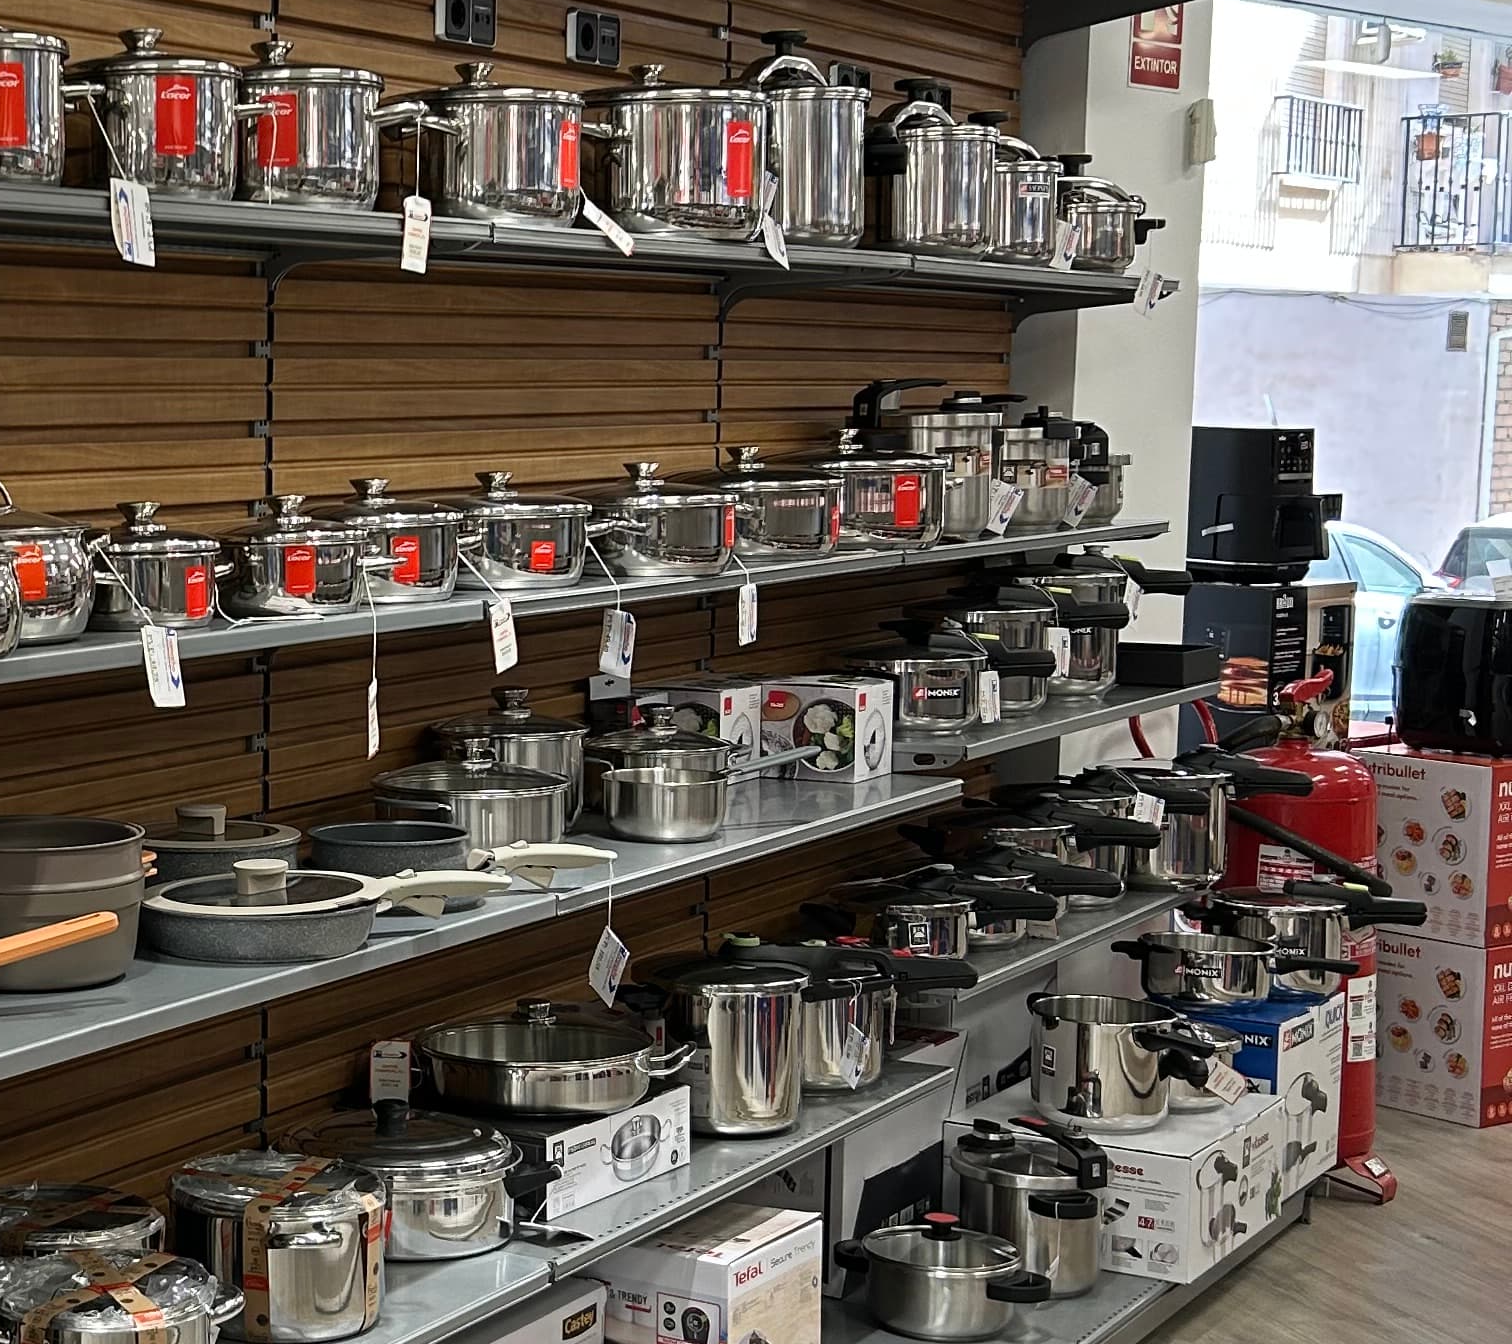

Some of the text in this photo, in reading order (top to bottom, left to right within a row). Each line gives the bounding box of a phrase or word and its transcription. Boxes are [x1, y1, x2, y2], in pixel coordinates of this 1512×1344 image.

[1134, 55, 1177, 75] EXTINTOR
[160, 89, 191, 101] Lacor
[394, 543, 417, 555] Lacor
[287, 552, 312, 563] Lacor
[927, 687, 962, 698] MONIX
[1364, 762, 1427, 781] utribullet
[1186, 968, 1219, 977] MONIX
[1291, 1020, 1313, 1044] MONIX
[1243, 1034, 1270, 1047] NIX
[1114, 1163, 1144, 1176] esse
[733, 1261, 763, 1287] Tefal
[617, 1289, 648, 1306] TRENDY
[564, 1308, 594, 1335] Castey
